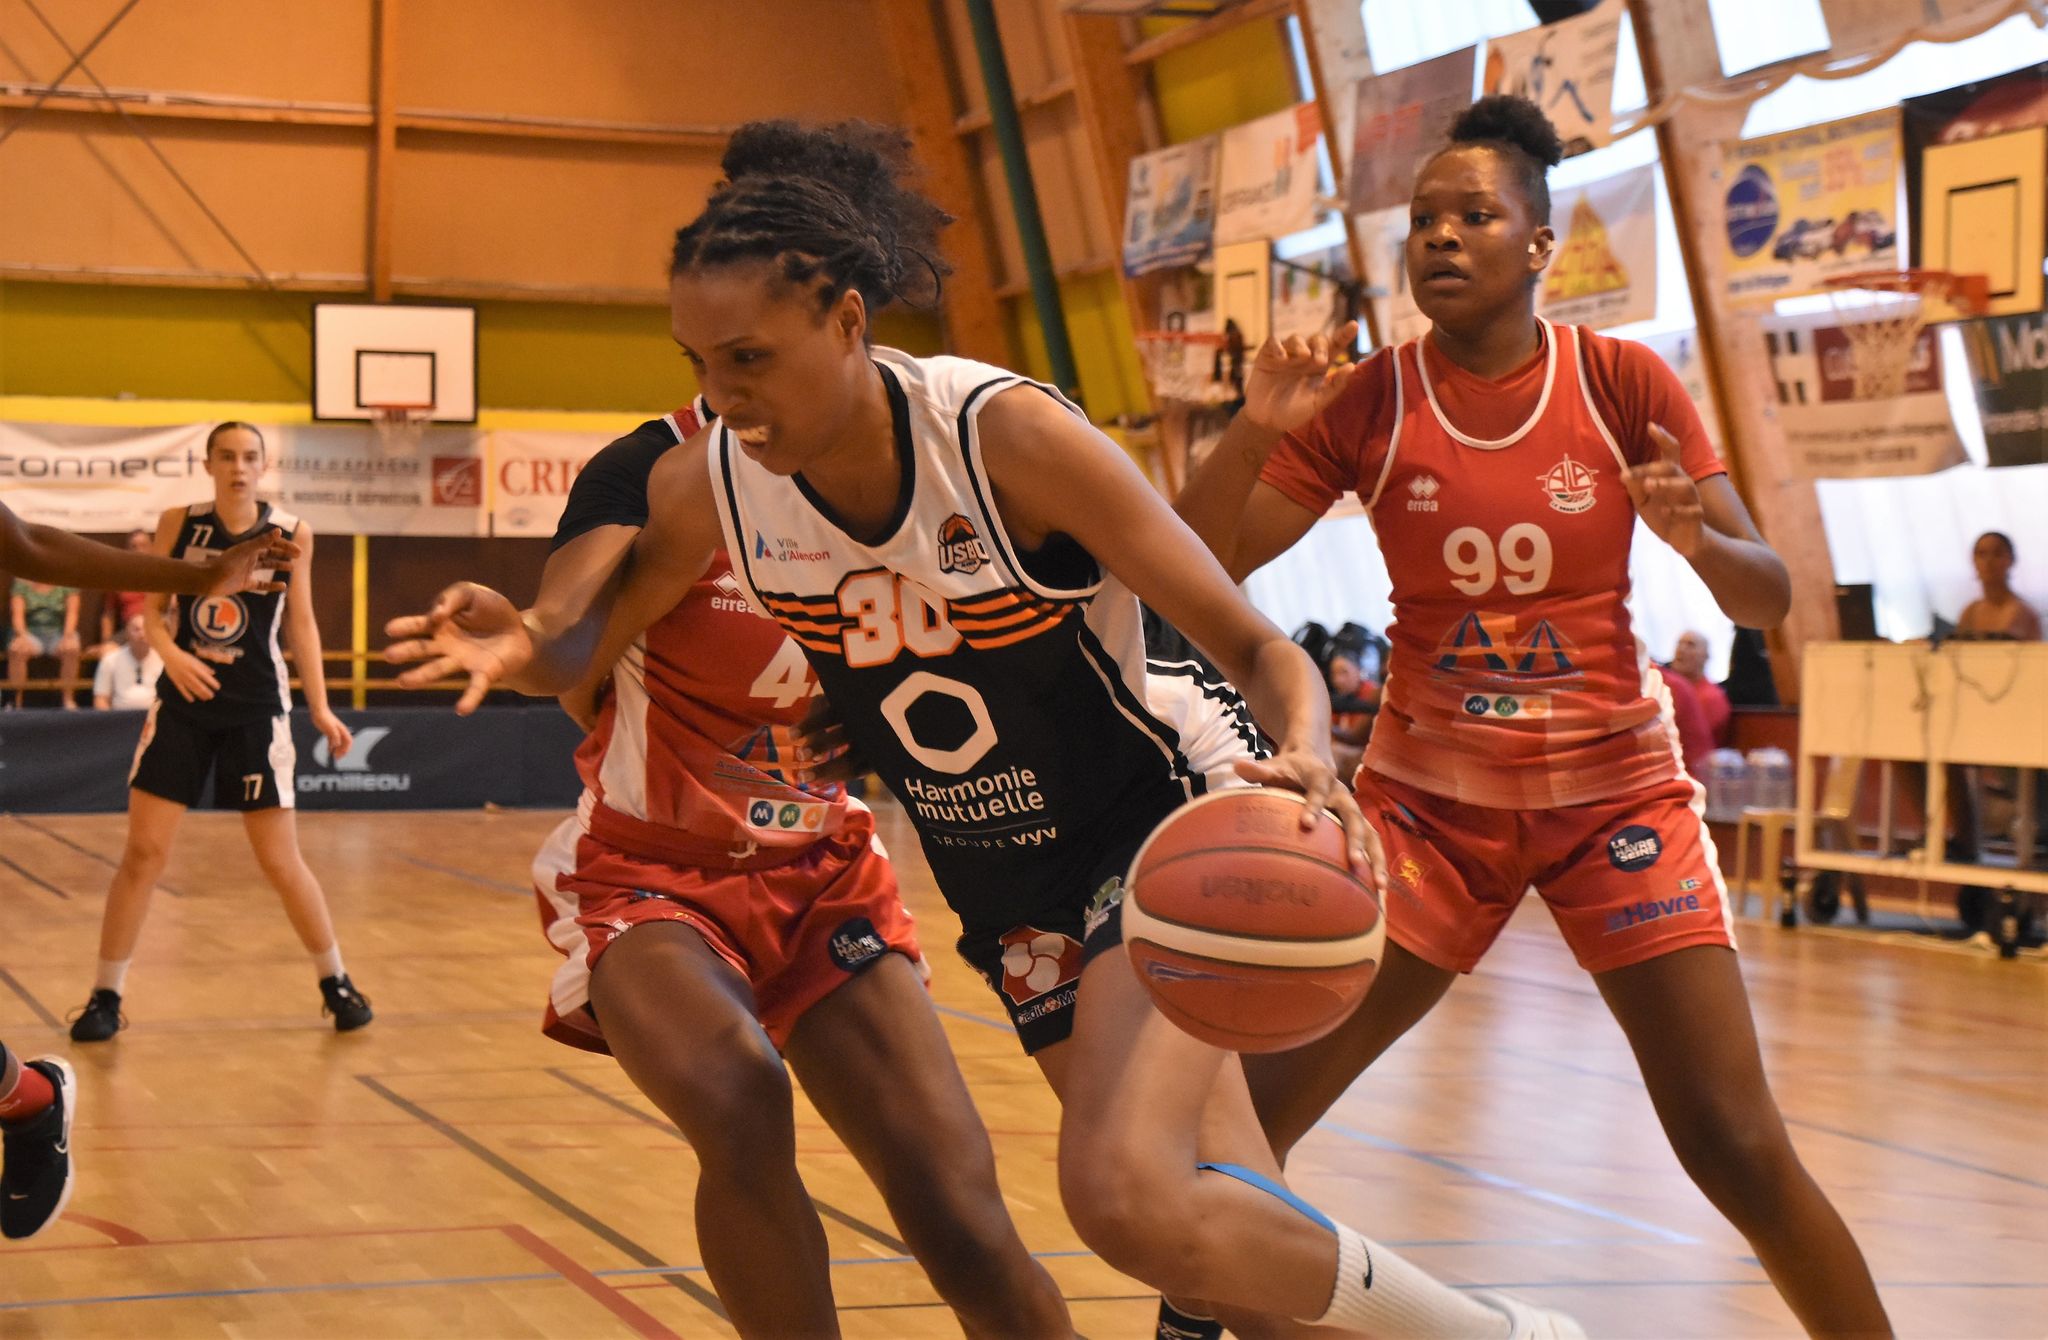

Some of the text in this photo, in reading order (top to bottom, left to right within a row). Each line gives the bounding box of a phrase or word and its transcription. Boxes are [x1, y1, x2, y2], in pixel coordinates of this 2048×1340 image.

[1406, 499, 1439, 511] errea
[191, 524, 214, 547] 77
[778, 550, 831, 562] d'Alençon
[1443, 522, 1553, 596] 99
[836, 567, 963, 669] 30
[297, 773, 410, 792] ornilleau
[904, 765, 1037, 803] Harmonie
[916, 790, 1044, 823] mutuelle
[1011, 826, 1057, 846] vyv
